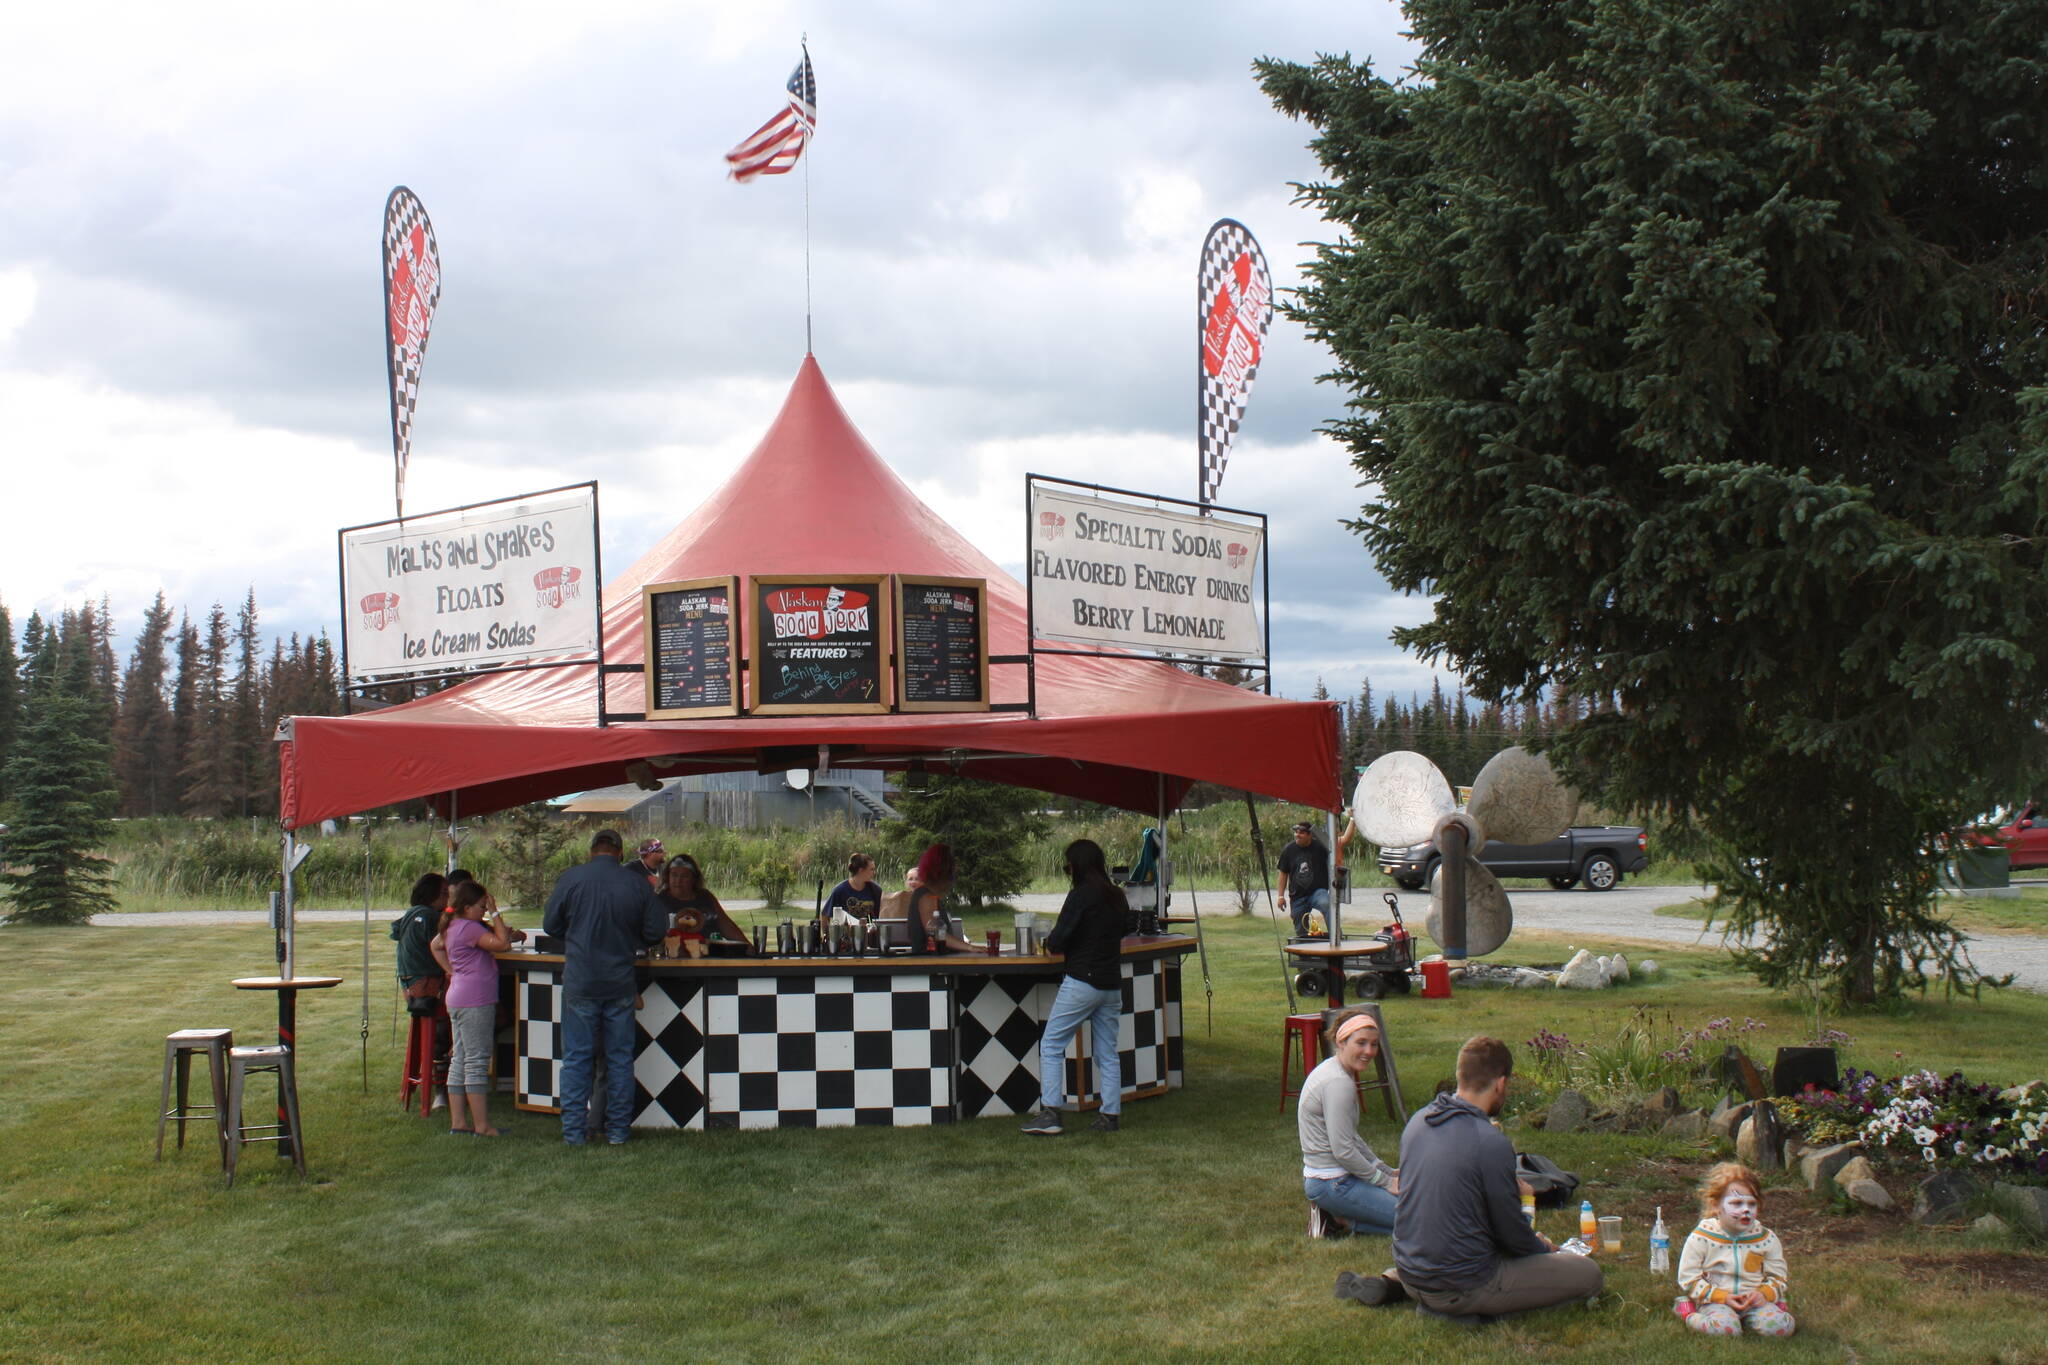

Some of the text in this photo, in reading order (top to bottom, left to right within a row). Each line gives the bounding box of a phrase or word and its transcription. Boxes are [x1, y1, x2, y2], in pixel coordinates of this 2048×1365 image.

[1075, 512, 1166, 551] SPECIALTY
[1172, 528, 1222, 560] SODAS
[1033, 549, 1250, 604] FLAVORED ENERGY DRINKS
[436, 582, 505, 614] FLOATS
[679, 604, 693, 612] SODA
[681, 596, 706, 605] ALASKAN
[778, 591, 823, 612] Alaskan
[1072, 598, 1226, 641] BERRY LEMONADE
[403, 620, 536, 660] Ice Cream Sodas
[790, 648, 847, 659] FEATURED
